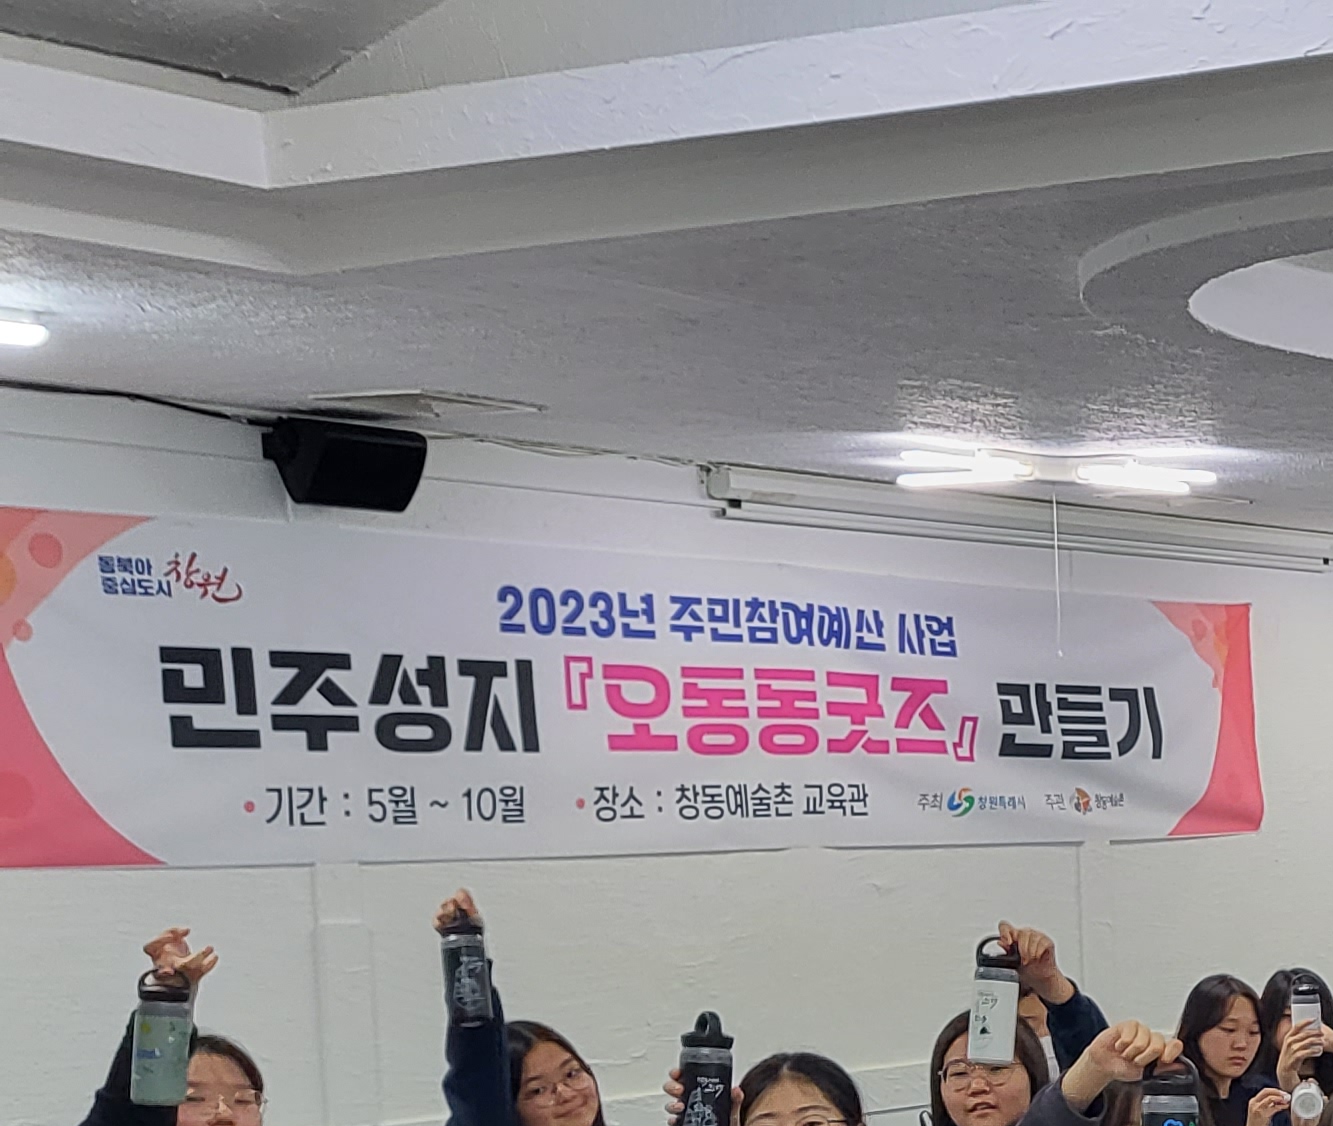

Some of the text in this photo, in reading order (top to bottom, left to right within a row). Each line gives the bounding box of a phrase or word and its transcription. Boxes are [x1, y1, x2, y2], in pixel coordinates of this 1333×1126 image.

[98, 555, 152, 576] 동북아
[164, 552, 242, 603] 창원
[101, 576, 172, 597] 중심도시
[497, 585, 957, 658] 2023년 주민참여예산 사업
[159, 646, 541, 753] 민주성지
[996, 681, 1163, 761] 만들기
[265, 786, 328, 826] 기간
[367, 786, 419, 825] 5월
[462, 785, 526, 824] 10월
[593, 786, 645, 823] 장소
[675, 783, 795, 821] 창동예술촌
[803, 783, 869, 819] 교육관
[918, 792, 943, 811] 주최
[1044, 792, 1067, 811] 주관
